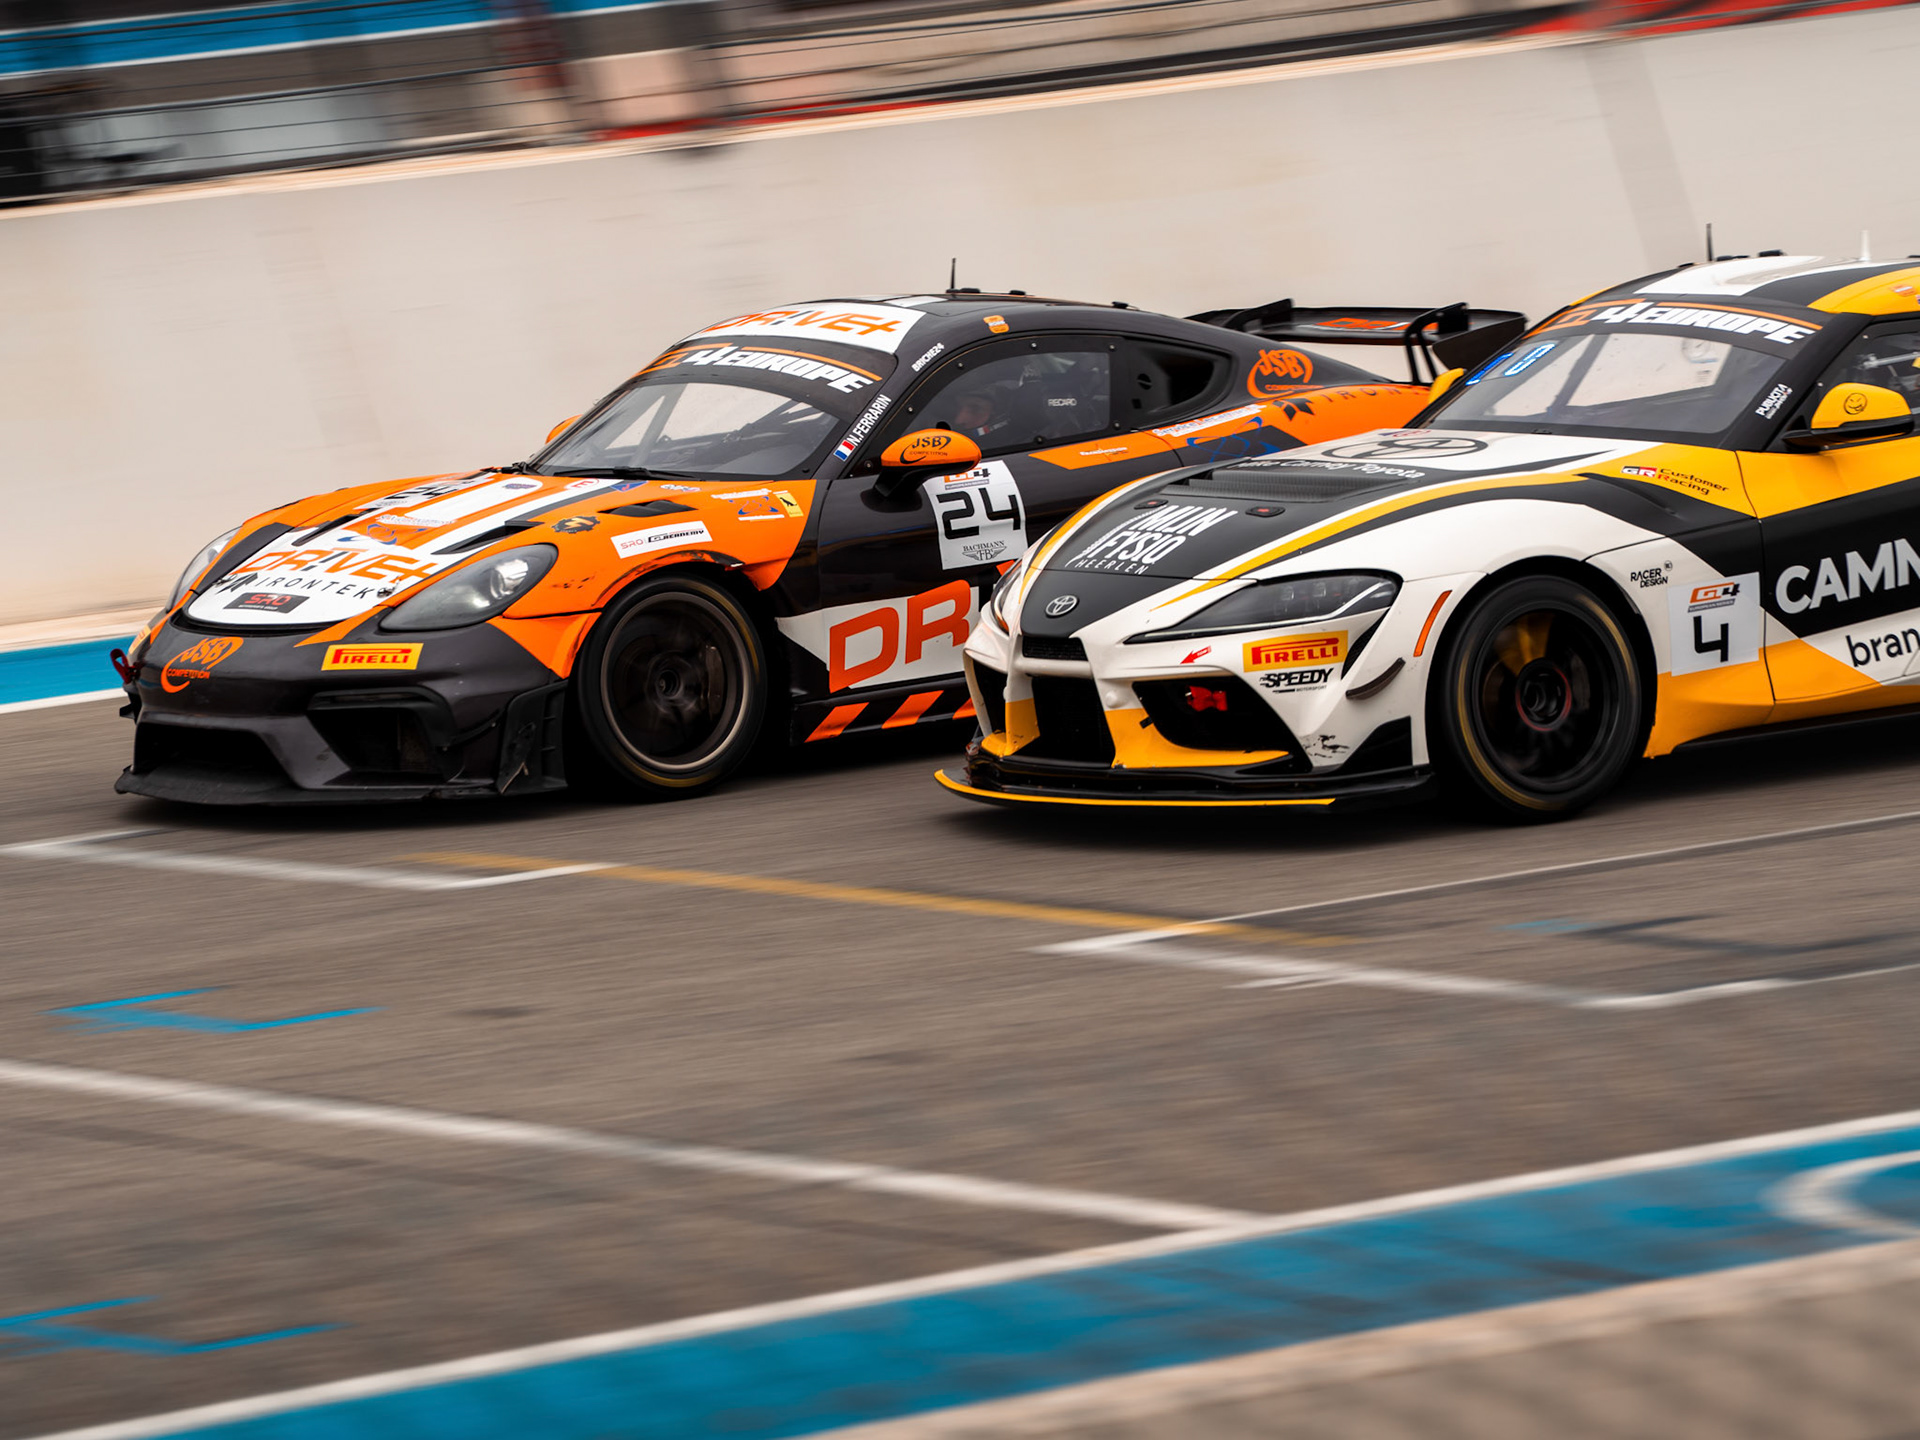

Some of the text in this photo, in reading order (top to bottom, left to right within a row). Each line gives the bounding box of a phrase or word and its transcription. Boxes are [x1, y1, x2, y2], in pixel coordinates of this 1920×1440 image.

[1628, 307, 1815, 344] EUROPE
[713, 350, 874, 394] EUROPE
[1258, 349, 1305, 379] JSB
[1048, 398, 1077, 406] RECARO
[846, 394, 892, 447] N.FERRARIN
[911, 436, 942, 449] JSB
[1353, 463, 1426, 479] Toyota
[1621, 466, 1729, 491] GR Customer
[1658, 474, 1710, 495] Racing
[936, 488, 1021, 540] 24
[620, 539, 644, 550] SRO
[963, 541, 1005, 552] BACHMANN
[229, 548, 438, 584] DRIVE+
[1075, 559, 1149, 575] HEERLEN
[1630, 568, 1662, 582] RACER
[254, 576, 375, 599] IRONTEK
[1640, 576, 1668, 588] DESIGN
[245, 593, 291, 606] SRO
[1693, 615, 1729, 663] 4
[180, 638, 229, 665] JSB
[331, 648, 412, 664] PIRELLI
[1251, 638, 1340, 665] PIRELLI
[167, 668, 211, 679] COMPETITION
[1265, 668, 1334, 688] SPEEDY
